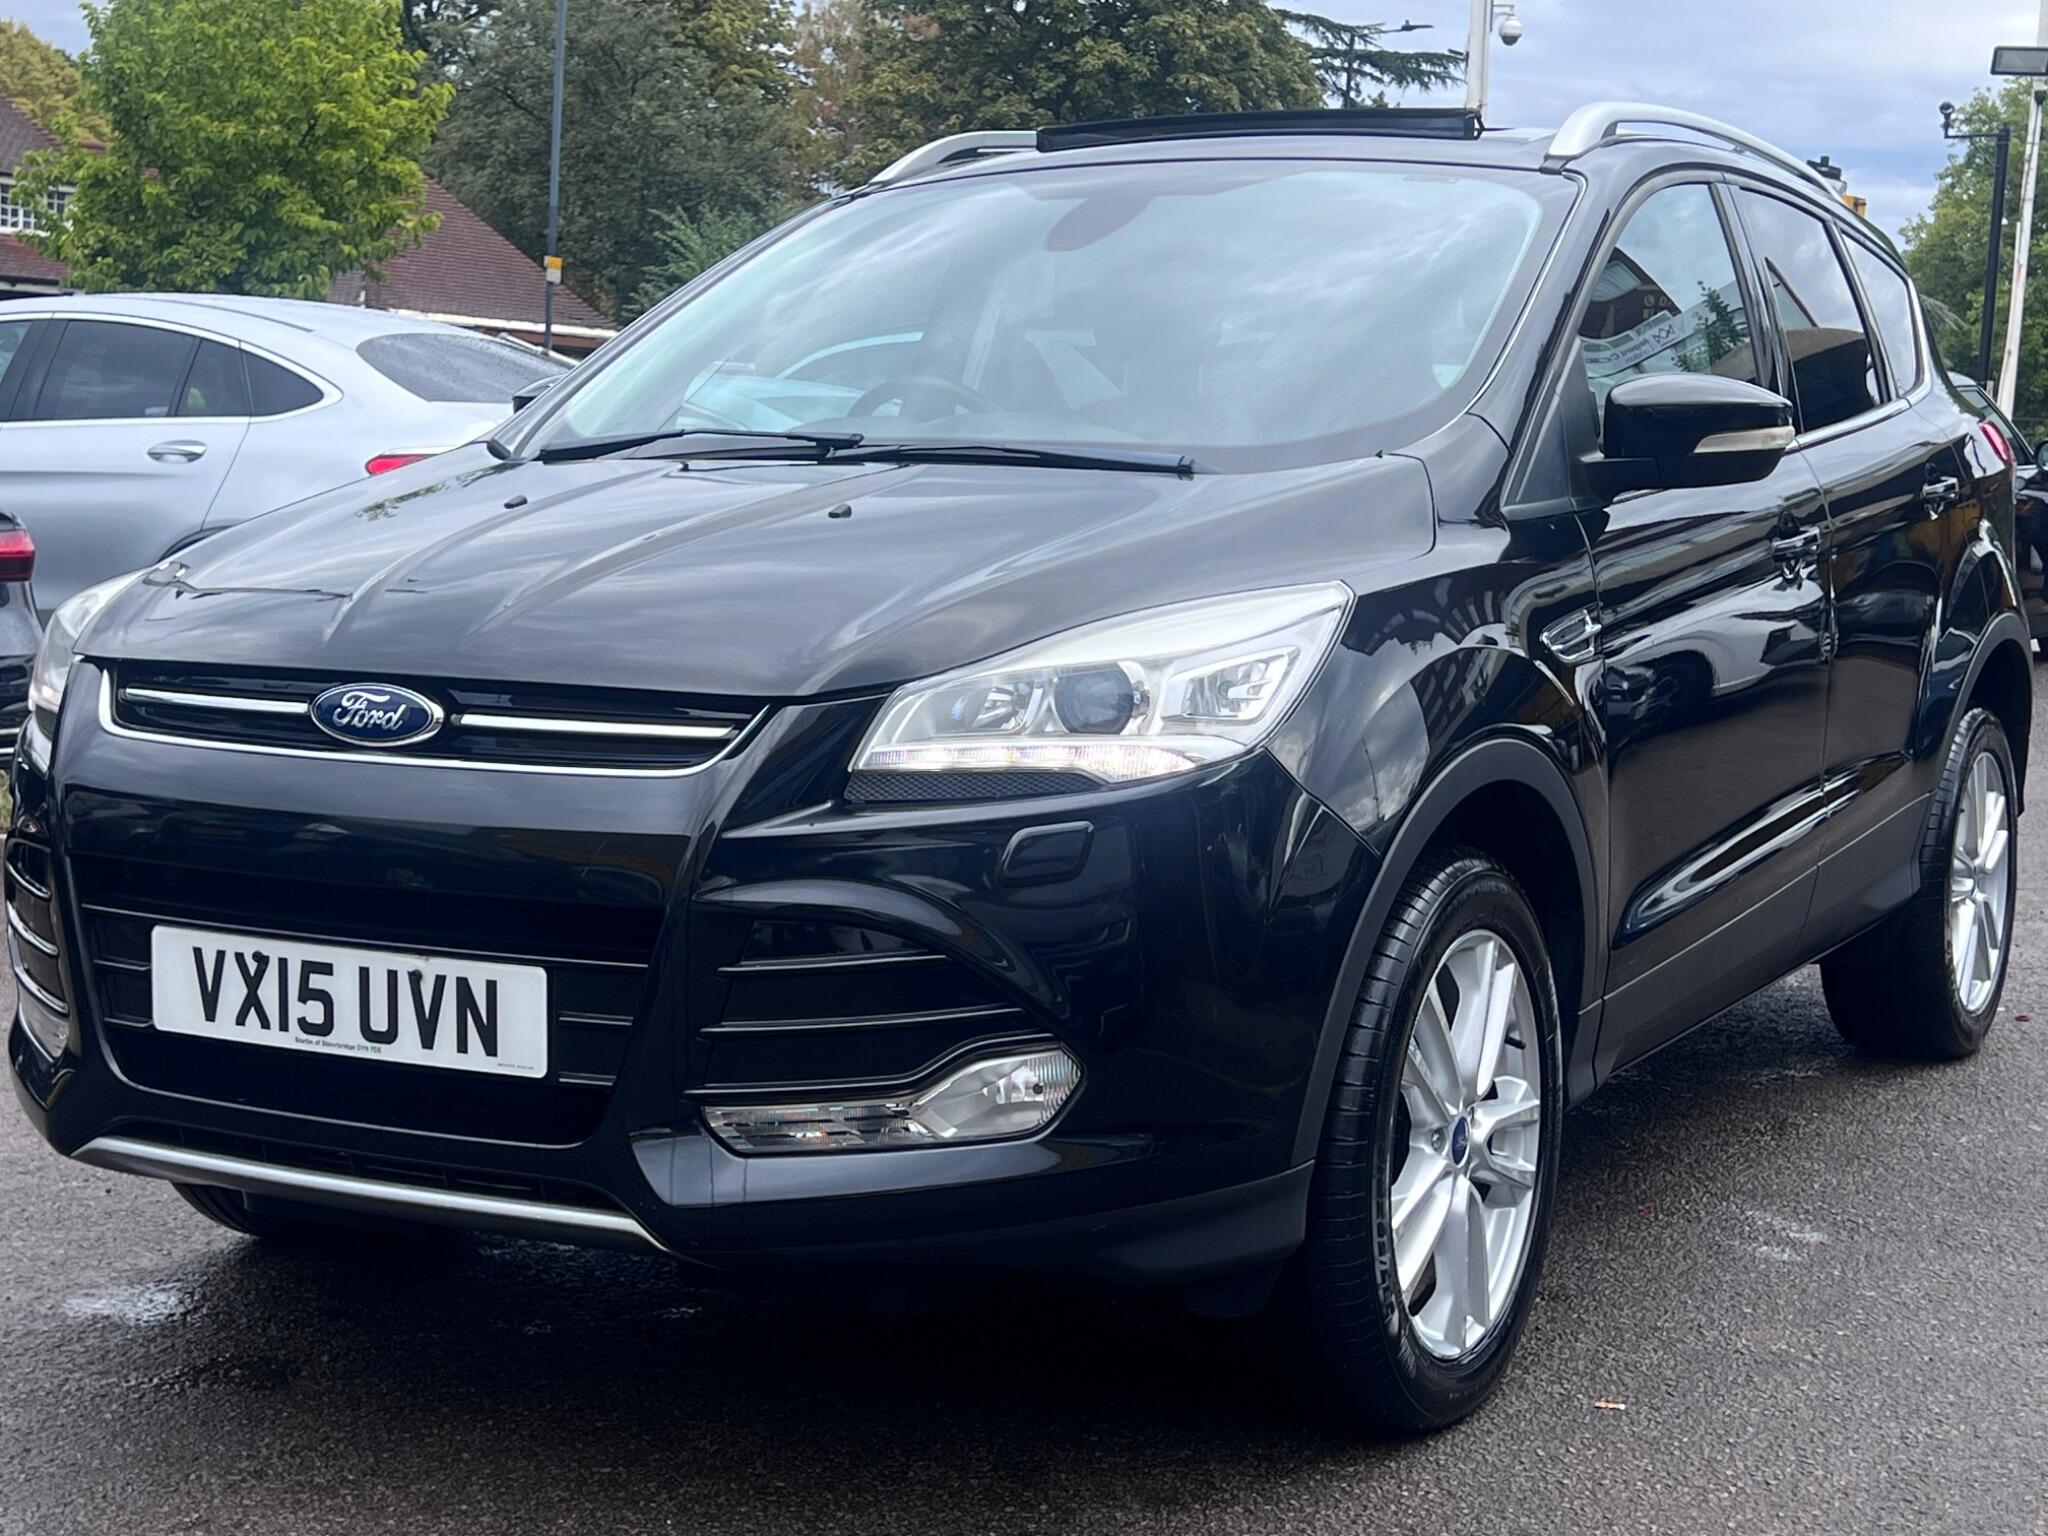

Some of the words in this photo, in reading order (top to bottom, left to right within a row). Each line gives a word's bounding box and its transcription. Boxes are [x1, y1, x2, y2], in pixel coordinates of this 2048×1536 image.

[332, 691, 407, 731] Ford
[192, 946, 335, 1038] VX15
[358, 966, 498, 1058] UVN
